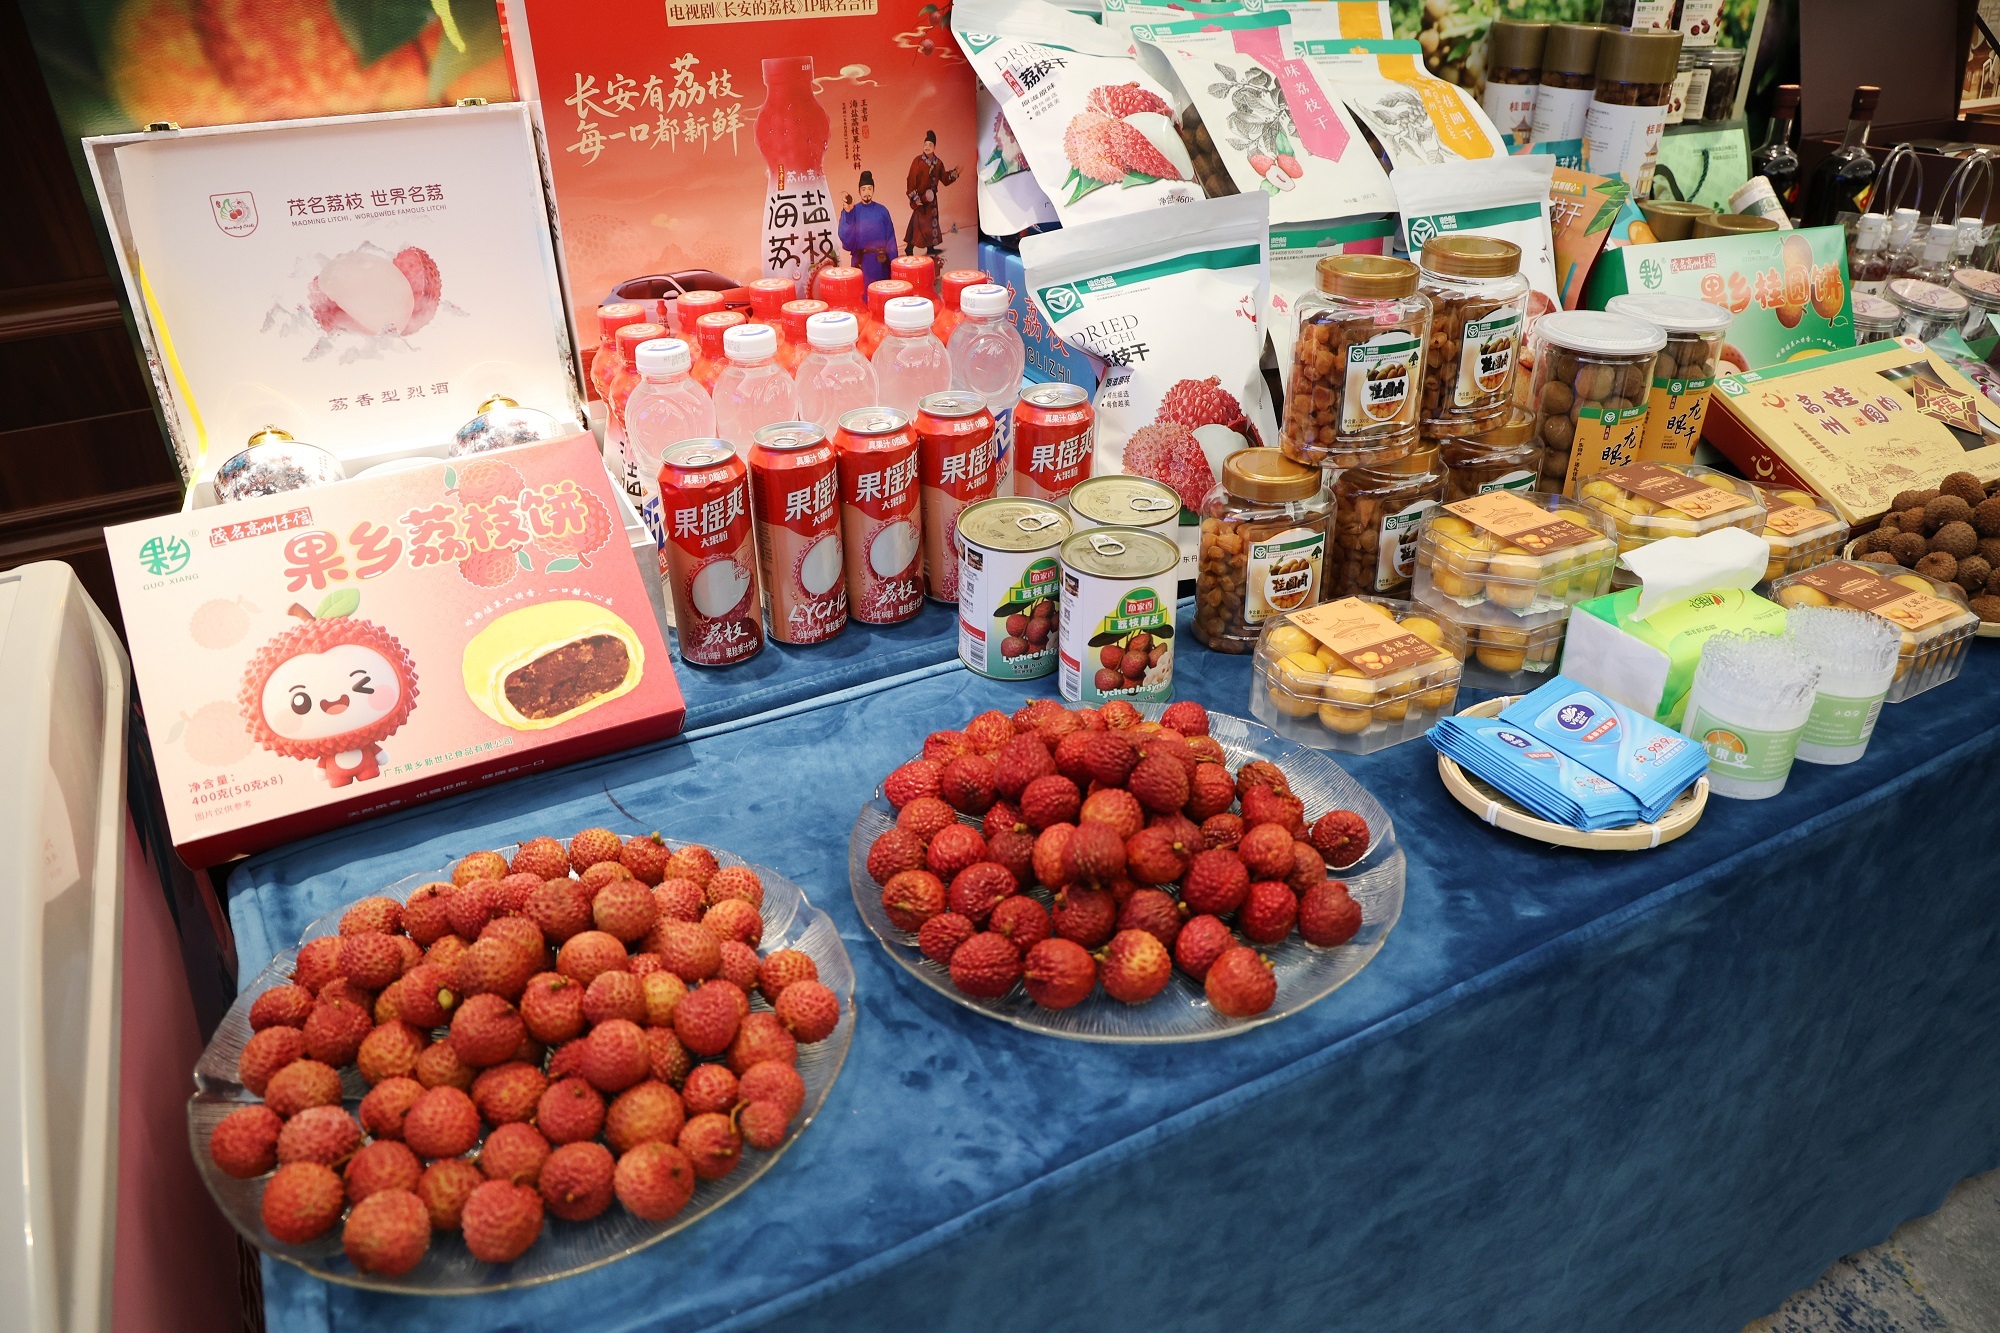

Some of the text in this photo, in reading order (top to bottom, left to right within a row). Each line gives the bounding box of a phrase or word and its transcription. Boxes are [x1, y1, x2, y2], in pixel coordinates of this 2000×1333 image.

[669, 0, 875, 20] 电视剧《长安的荔枝》IP联名合作
[1018, 57, 1069, 91] 荔枝干
[565, 52, 745, 120] 长安有荔枝
[861, 98, 869, 122] 王老吉
[566, 102, 746, 168] 每一口都新鲜
[849, 99, 862, 171] 海盐荔枝果汁饮料
[286, 183, 445, 217] 茂名荔枝 世界名荔
[768, 189, 831, 231] 海盐
[291, 217, 326, 227] MAOMING
[354, 209, 396, 220] WORLDWIDE
[397, 206, 426, 215] FAMOUS
[426, 204, 447, 213] LITCHI
[768, 228, 834, 271] 荔枝
[1700, 260, 1845, 315] 果乡桂圆饼
[1070, 314, 1139, 349] DRIED
[329, 381, 450, 412] 荔香型烈酒
[953, 421, 975, 434] 真果汁
[1044, 413, 1067, 424] 真果汁
[868, 439, 891, 450] 真果汁
[1029, 426, 1094, 474] 果摇爽
[796, 453, 818, 466] 真果汁
[683, 469, 729, 485] 真果汁 0脂肪
[855, 446, 919, 503] 果摇爽
[965, 473, 988, 492] 大果粒
[1053, 471, 1079, 483] 大果粒
[674, 483, 745, 539] 果摇爽
[881, 493, 907, 511] 大果粒
[212, 510, 311, 545] 茂名高州手信
[811, 505, 834, 527] 大果粒
[284, 480, 591, 595] 果乡荔枝饼
[700, 530, 729, 549] 大果粒
[143, 573, 200, 591] GUO XIANG
[875, 579, 918, 608] 荔枝
[1271, 571, 1309, 594] 桂圆肉
[702, 620, 749, 648] 荔枝
[1116, 615, 1159, 630] 荔枝罐头
[1381, 636, 1420, 653] 荔枝饼
[1002, 651, 1039, 665] Lychee
[1096, 679, 1169, 699] Lychee in Syrup
[383, 736, 514, 778] 广东果乡新世纪食品有限公司
[1701, 739, 1749, 762] 水果叉
[194, 800, 252, 821] 图片仅供参考
